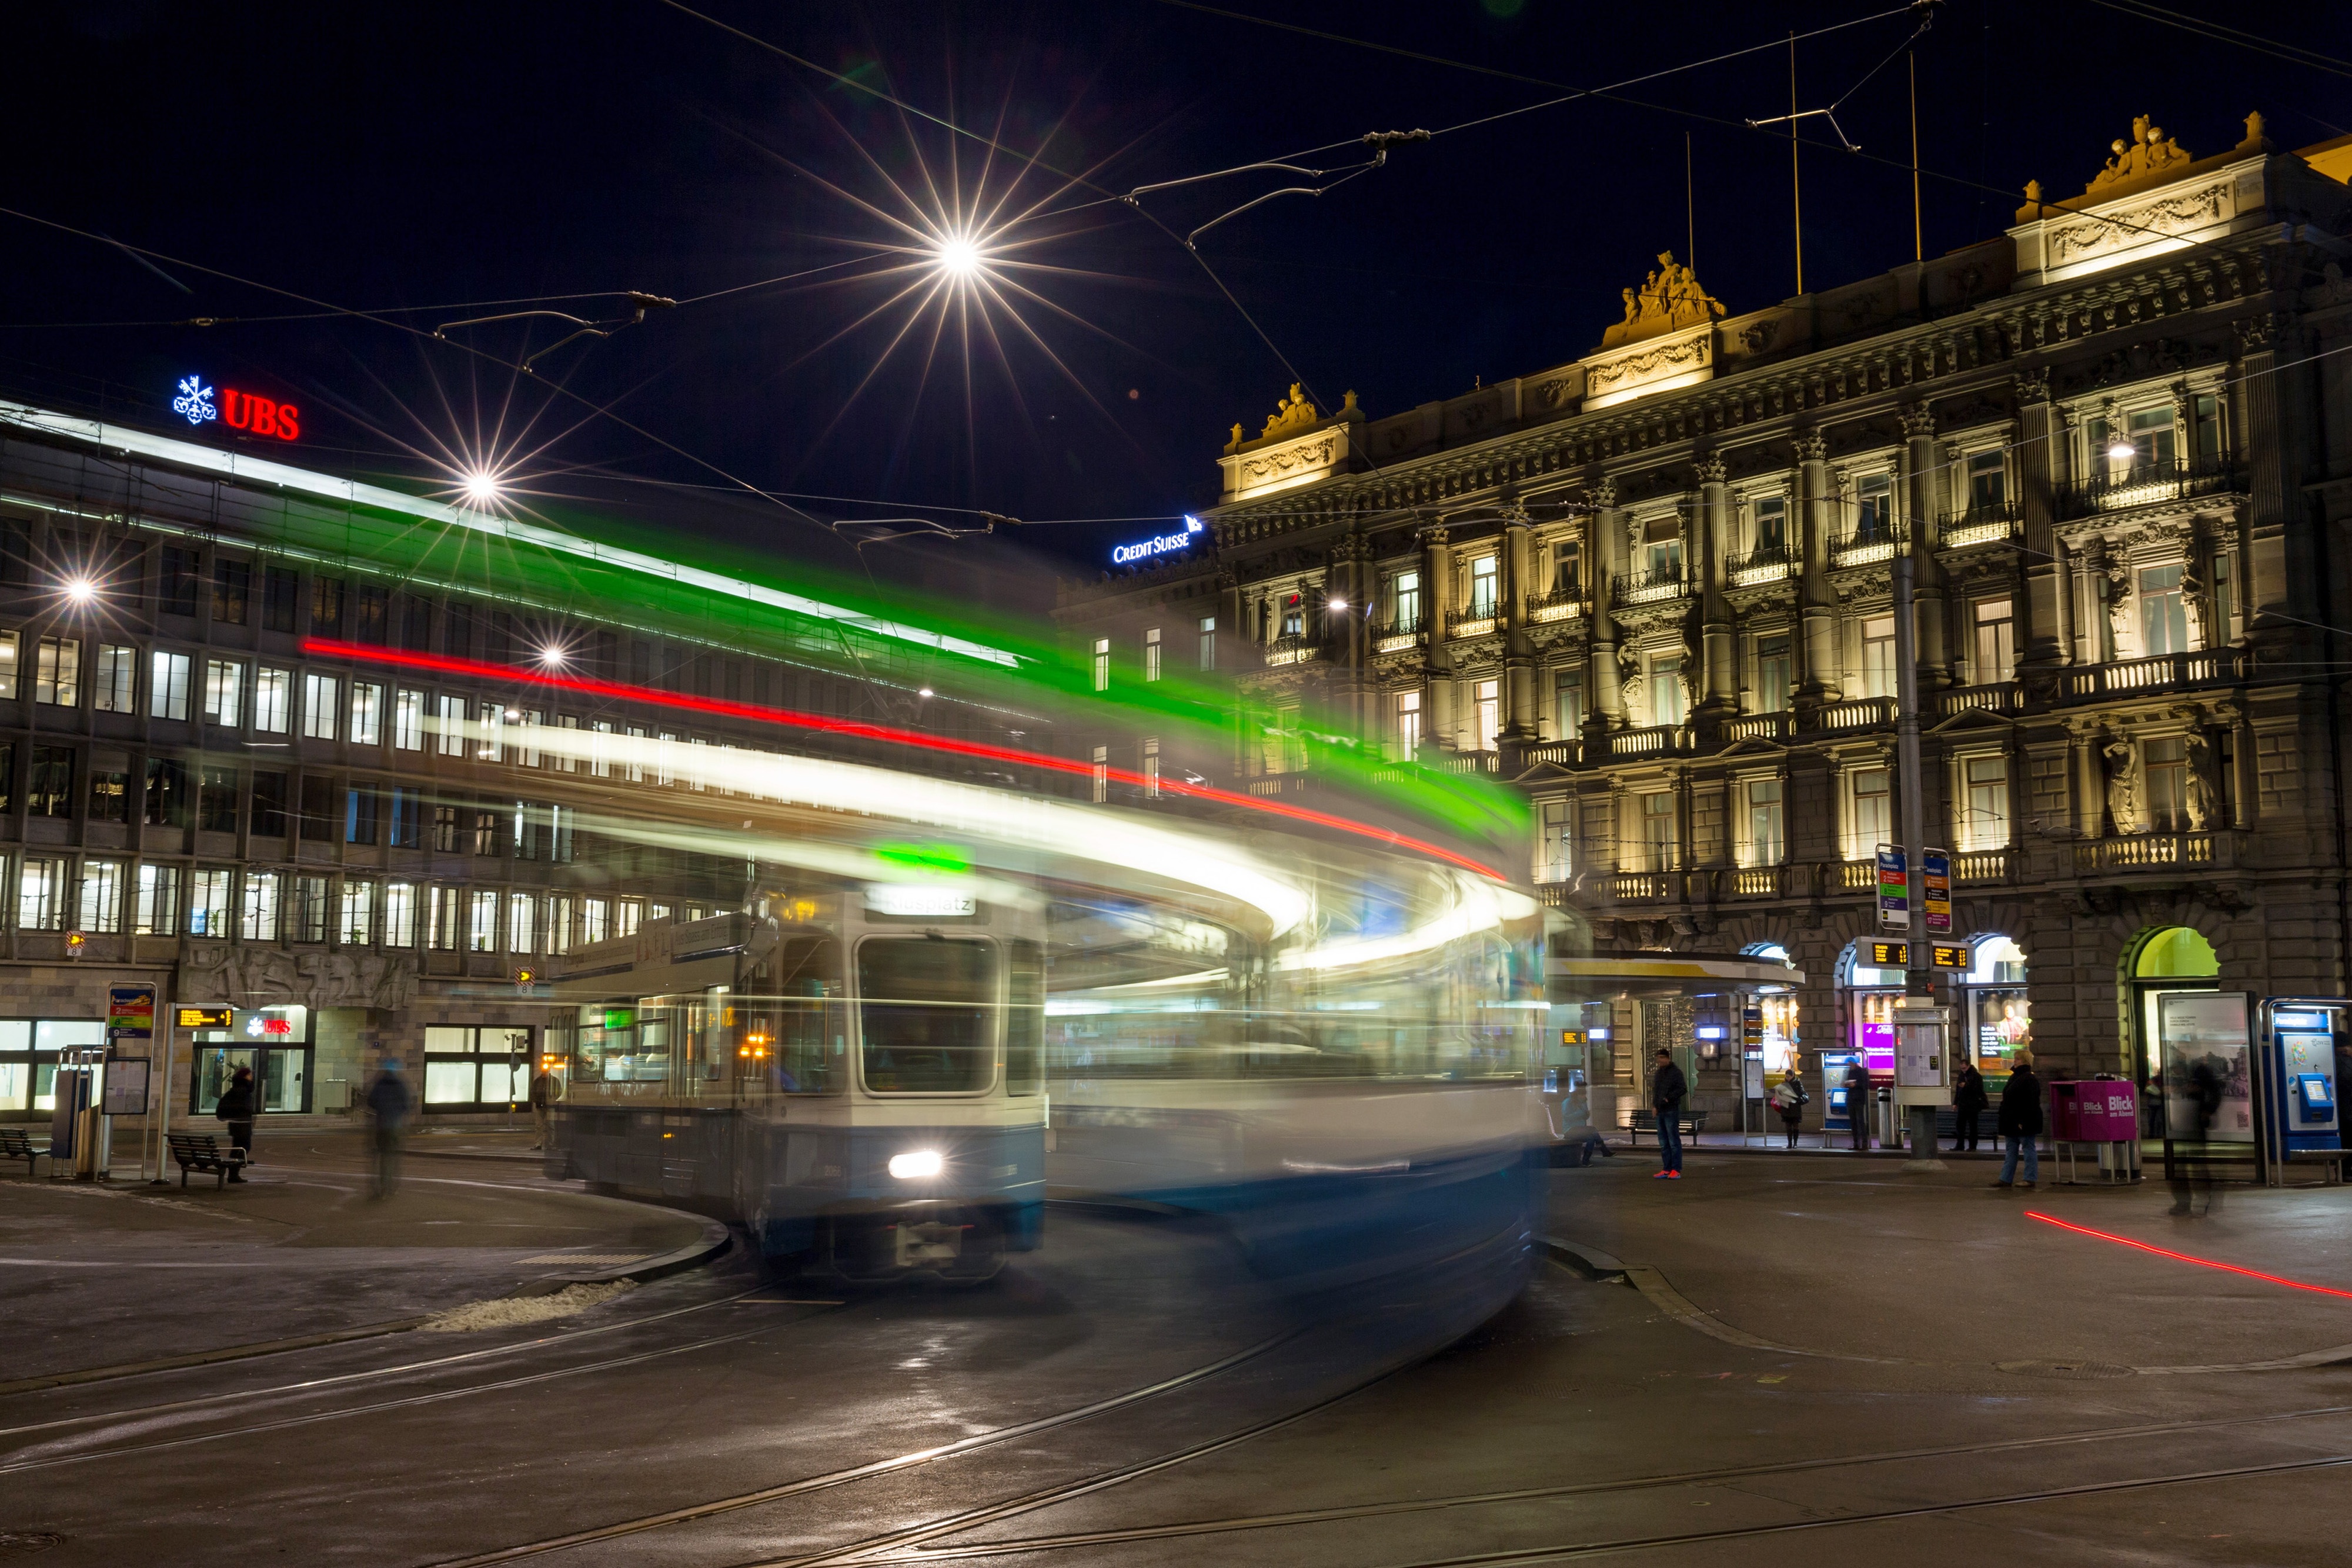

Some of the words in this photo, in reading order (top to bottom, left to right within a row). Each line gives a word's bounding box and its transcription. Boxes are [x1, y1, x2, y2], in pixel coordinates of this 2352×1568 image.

[224, 389, 299, 440] UBS
[1114, 540, 1153, 563] CREDIT
[1154, 532, 1189, 553] SUISSE
[887, 895, 970, 913] Klusplatz
[265, 1019, 290, 1034] UBS
[2083, 1102, 2103, 1111] Blick
[2108, 1095, 2133, 1111] Blick
